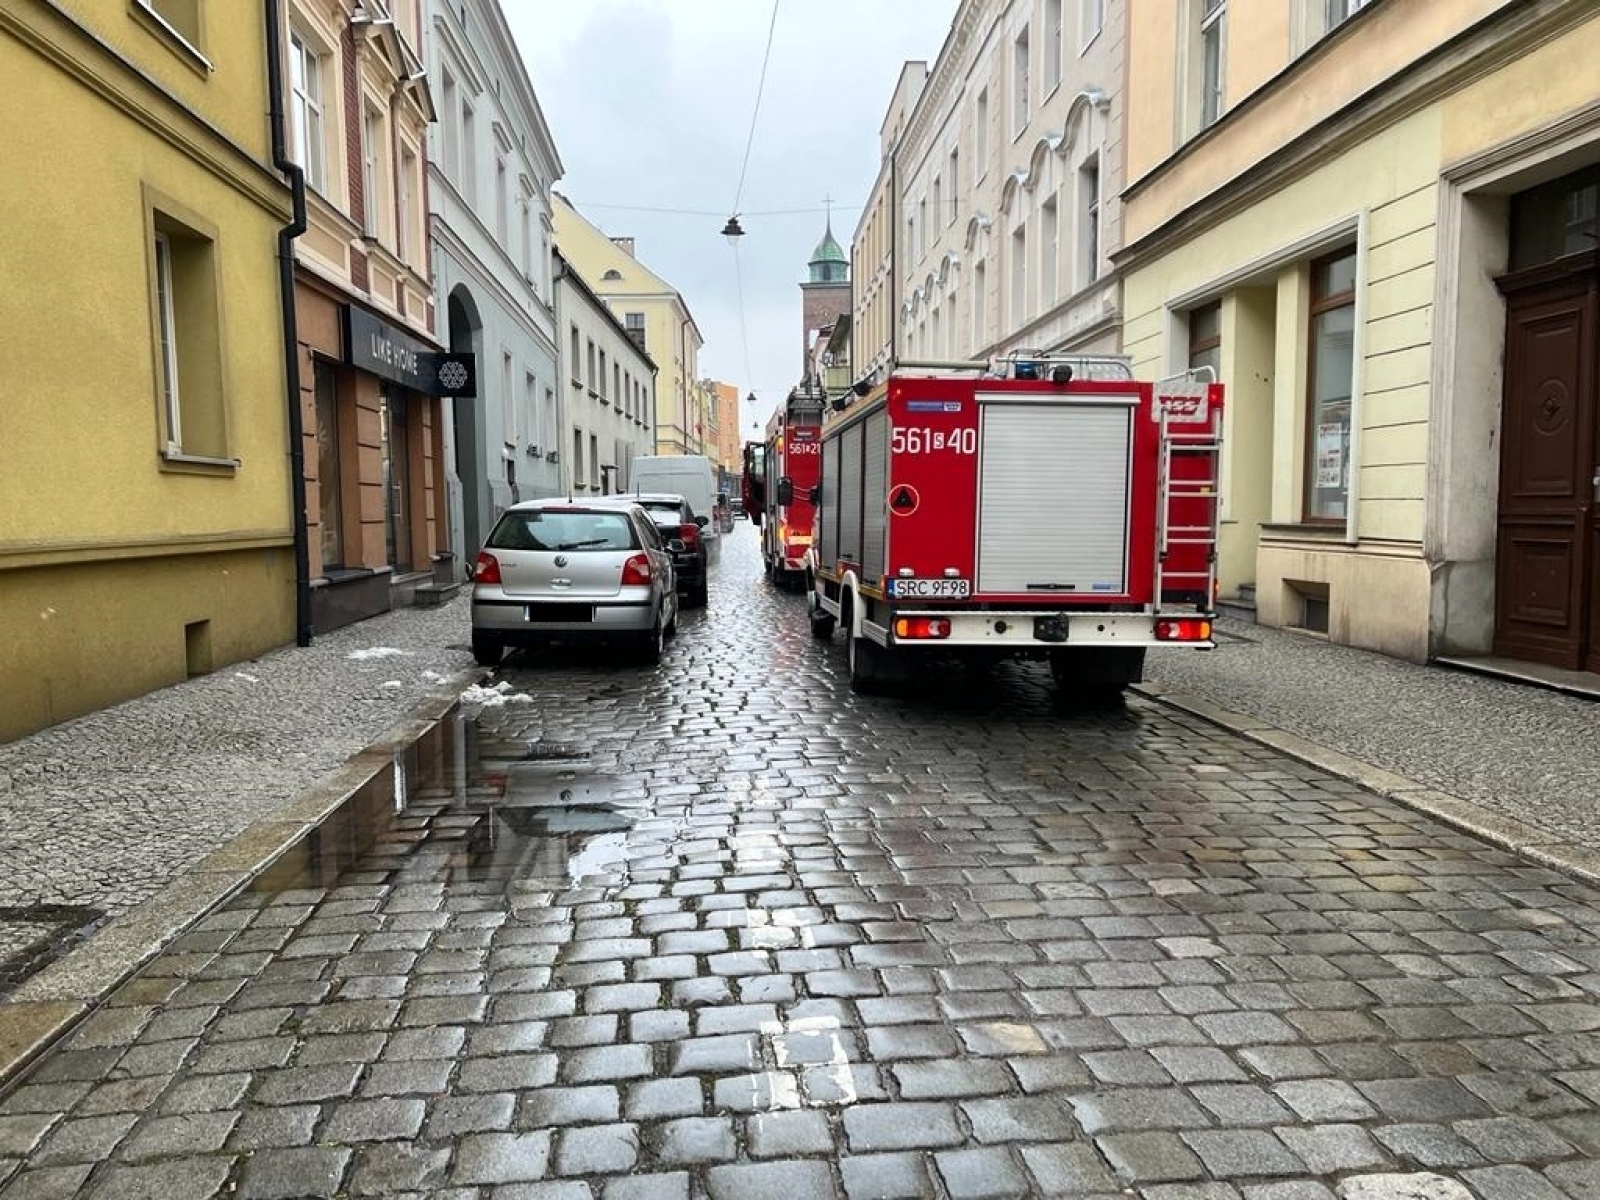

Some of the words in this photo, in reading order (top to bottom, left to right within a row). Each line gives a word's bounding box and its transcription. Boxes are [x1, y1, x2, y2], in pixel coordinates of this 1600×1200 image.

[371, 332, 392, 365] LIKE
[393, 345, 418, 376] HOME
[896, 580, 928, 595] SRC
[932, 580, 968, 595] 9F98
